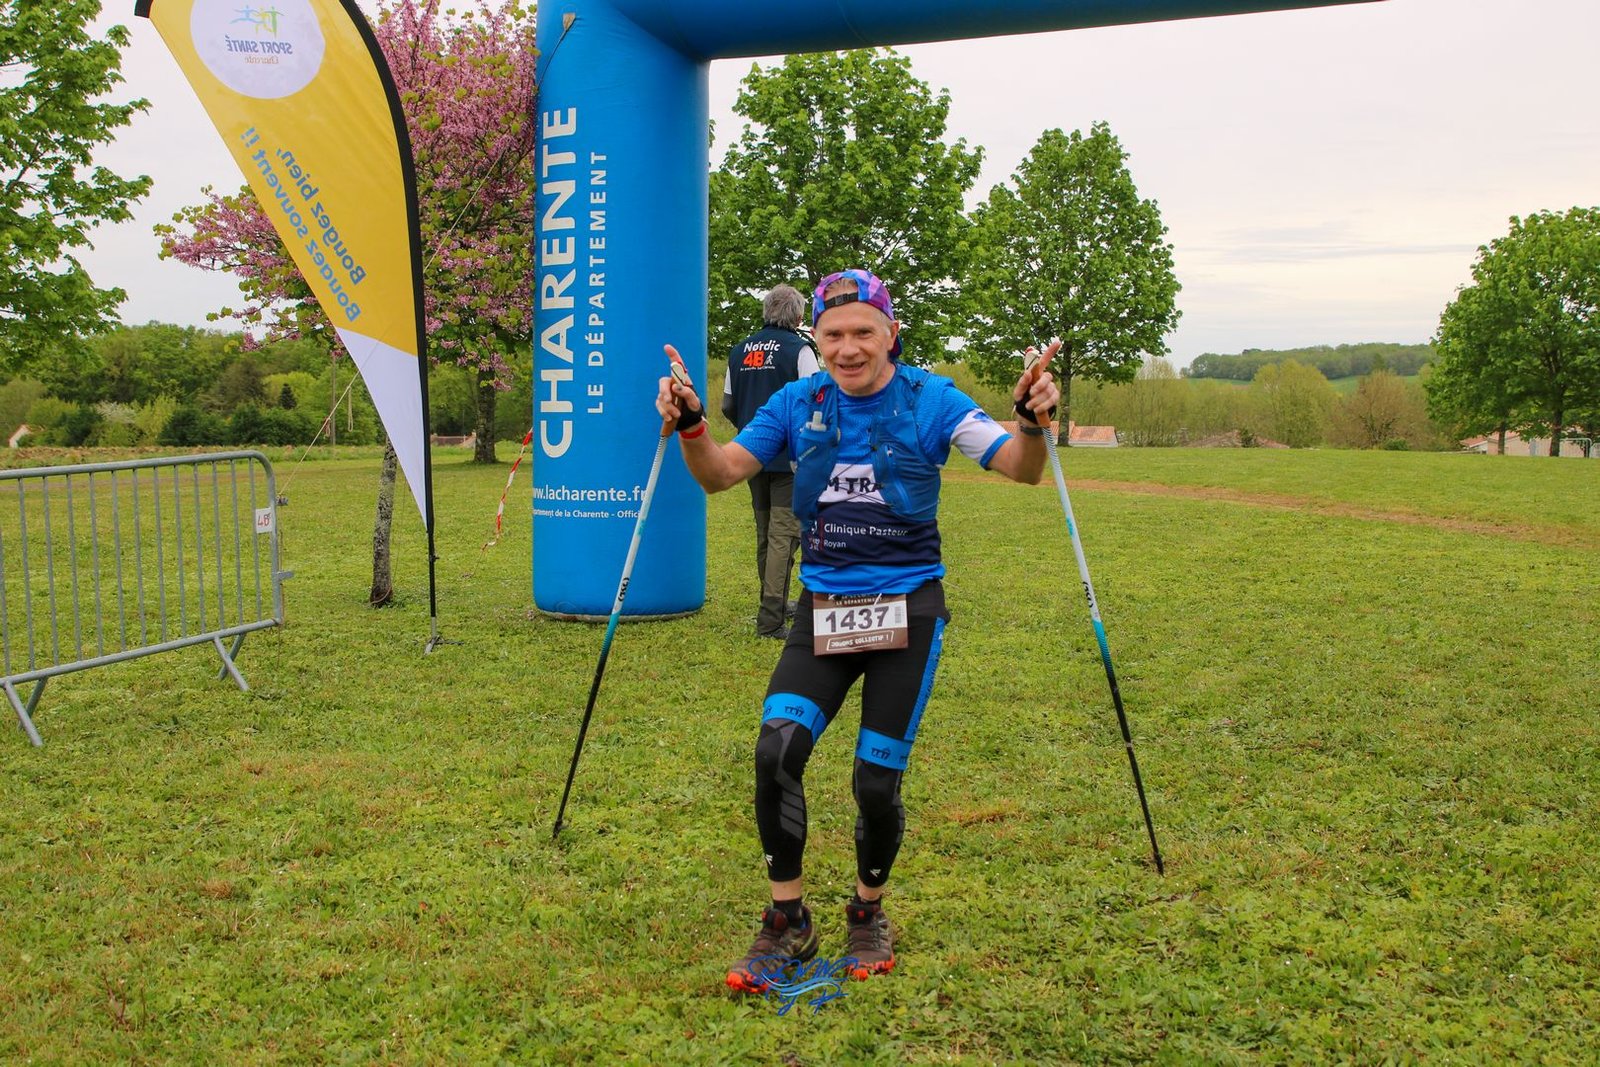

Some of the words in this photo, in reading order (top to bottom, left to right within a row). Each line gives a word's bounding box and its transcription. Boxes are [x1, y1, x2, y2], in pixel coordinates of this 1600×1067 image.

[585, 151, 608, 367] DÉPARTEMENT
[540, 106, 577, 459] CHARENTE
[587, 383, 604, 414] LE
[572, 509, 609, 519] Charente
[823, 523, 868, 536] Clinique
[869, 526, 909, 537] Pasteur
[823, 539, 847, 549] Royan
[825, 606, 890, 633] 1437
[854, 634, 884, 645] COLLECTIF
